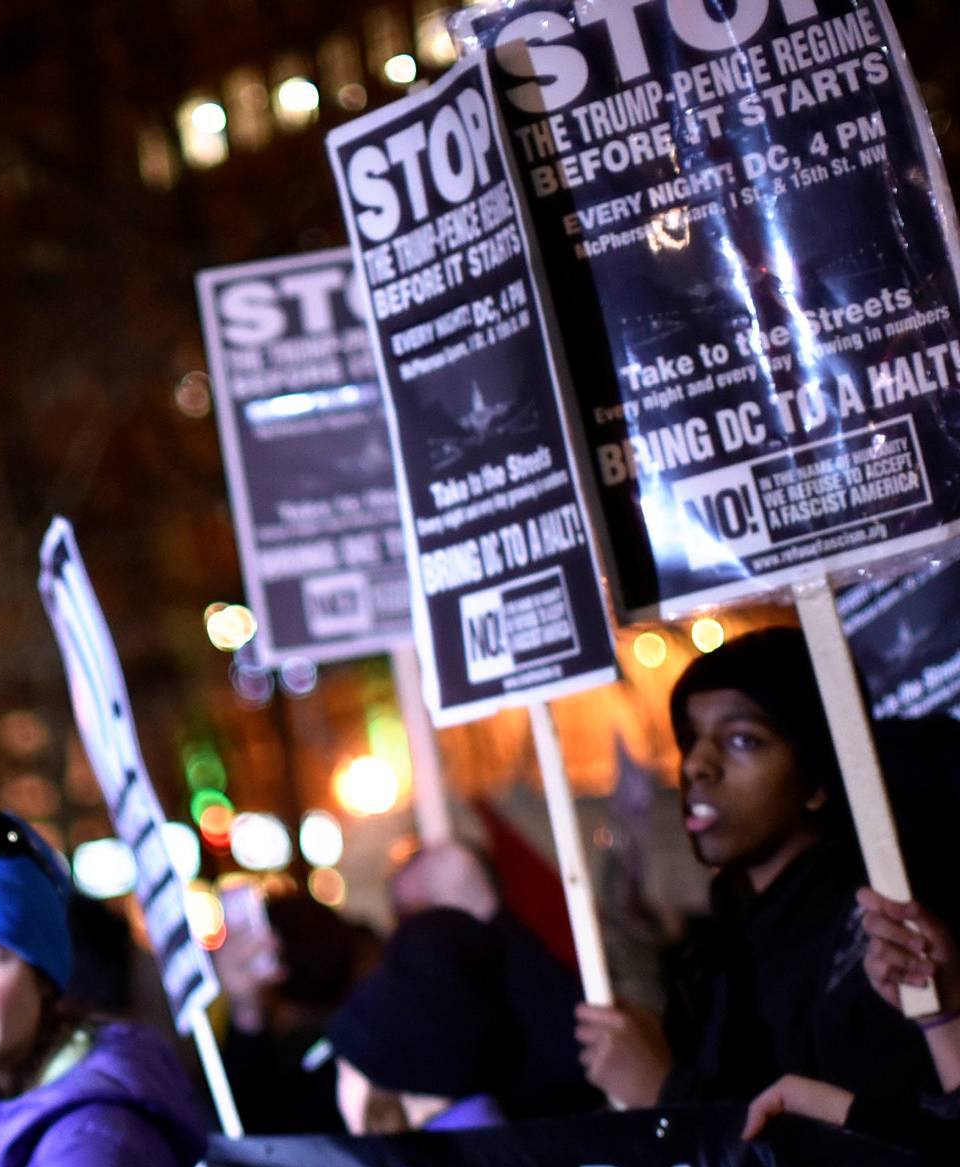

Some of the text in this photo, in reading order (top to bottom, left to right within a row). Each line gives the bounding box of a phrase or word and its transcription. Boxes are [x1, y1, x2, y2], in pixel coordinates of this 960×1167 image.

[494, 0, 818, 114] STO
[515, 7, 881, 162] THE TRUMP-PENCE REGIME
[348, 87, 491, 241] STOP
[529, 51, 889, 199] BEFORE IT STARTS
[562, 110, 887, 237] EVERY NIGHT! DC, 4 PM
[773, 177, 788, 196] &
[790, 165, 829, 189] 15th
[831, 156, 857, 177] St.
[859, 143, 887, 168] NW
[373, 262, 446, 320] BEFORE
[443, 252, 464, 289] IT
[620, 354, 695, 392] Take
[699, 343, 730, 369] to
[801, 287, 913, 337] Streets
[642, 384, 685, 411] night
[687, 373, 715, 398] and
[716, 364, 758, 389] every
[865, 324, 883, 344] in
[885, 305, 951, 338] numbers
[597, 339, 960, 488] BRING DC TO A HALT!
[763, 451, 914, 509] WE REFUSE TO ACCEPT
[769, 470, 920, 530] A FASCIST AMERICA
